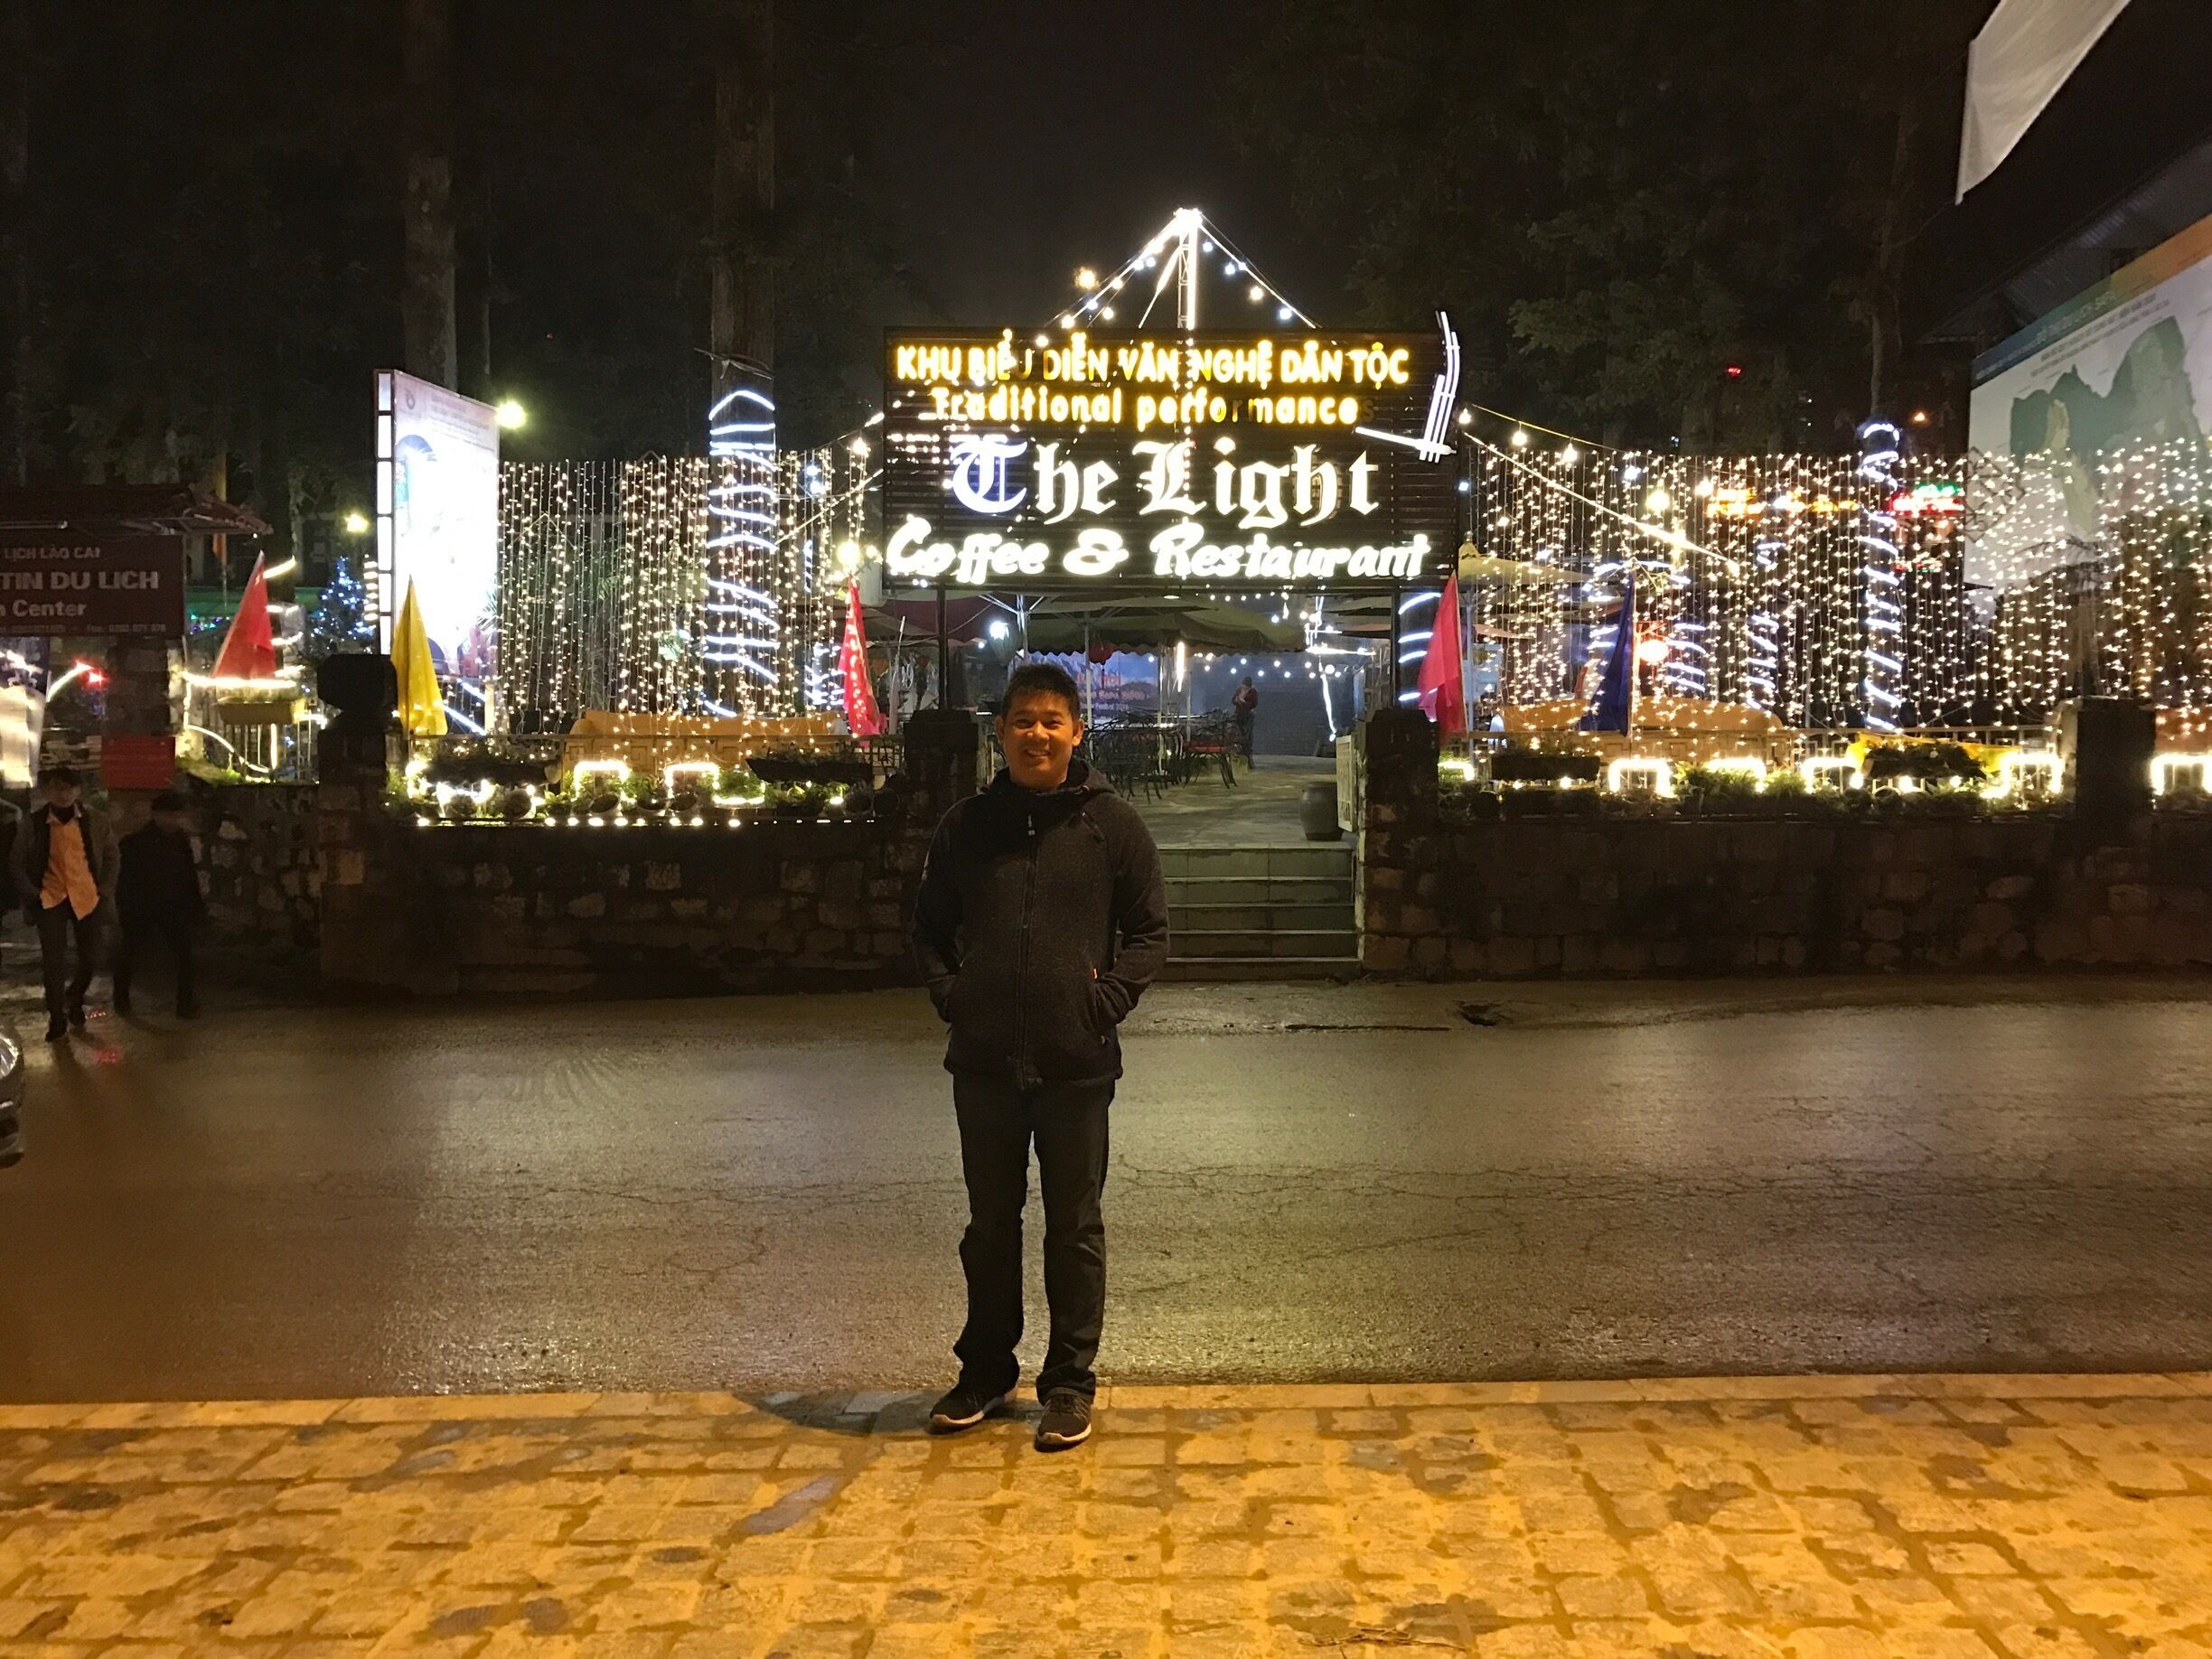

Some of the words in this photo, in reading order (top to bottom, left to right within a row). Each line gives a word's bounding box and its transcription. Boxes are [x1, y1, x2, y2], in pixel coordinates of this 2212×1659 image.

[1348, 342, 1409, 389] TỘC
[931, 384, 1121, 423] Traditional
[950, 440, 1119, 524] The
[1131, 436, 1379, 529] Light
[74, 547, 100, 558] CAI
[886, 514, 1049, 585] Coffee
[1063, 528, 1129, 576] &
[1149, 522, 1431, 578] Restaurant
[0, 571, 42, 590] TIN
[50, 571, 90, 590] DU
[12, 599, 87, 617] Center
